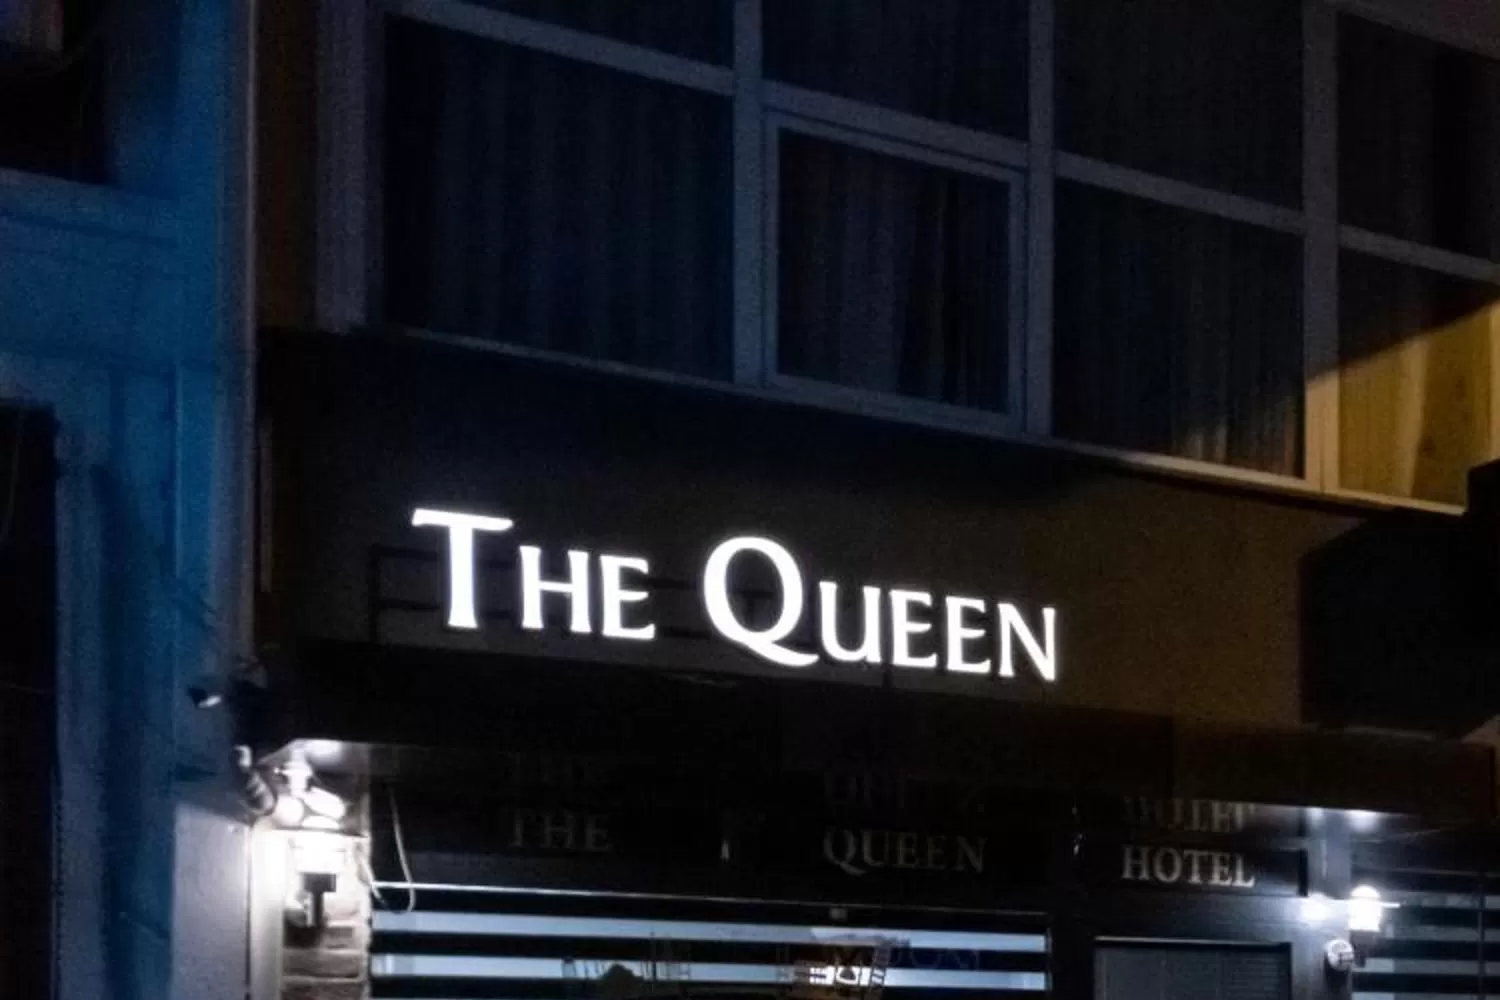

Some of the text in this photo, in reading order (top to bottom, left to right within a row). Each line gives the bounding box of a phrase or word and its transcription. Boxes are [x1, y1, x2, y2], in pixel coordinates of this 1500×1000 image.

[411, 507, 1059, 682] THE QUEEN
[502, 808, 1255, 888] THE QUEEN HOTEL
